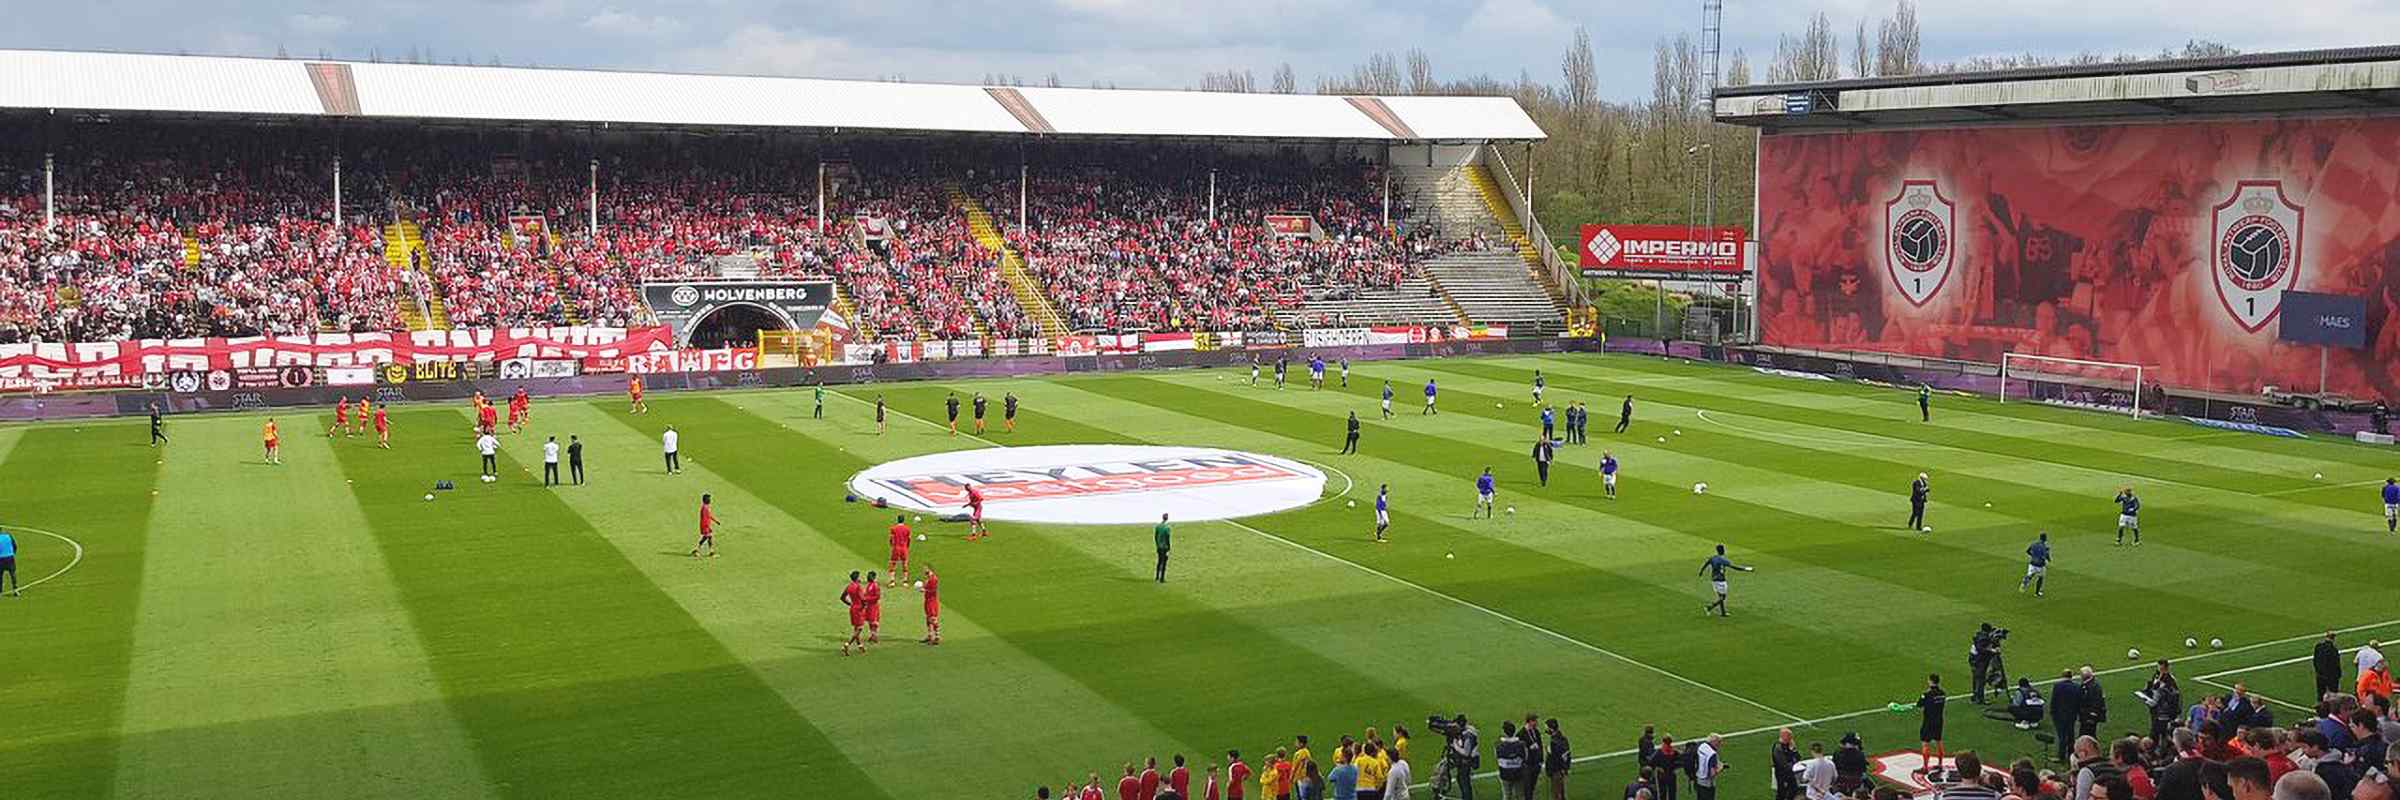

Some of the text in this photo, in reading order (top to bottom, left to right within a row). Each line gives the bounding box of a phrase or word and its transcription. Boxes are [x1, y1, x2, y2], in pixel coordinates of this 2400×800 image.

[1623, 238, 1737, 257] IMPERMO
[703, 288, 807, 302] HOLVENBERG
[1913, 278, 1921, 294] 1
[2246, 297, 2255, 317] 1
[2319, 314, 2351, 330] MAES
[415, 358, 458, 381] ELITE
[886, 454, 1259, 490] HEYLEN
